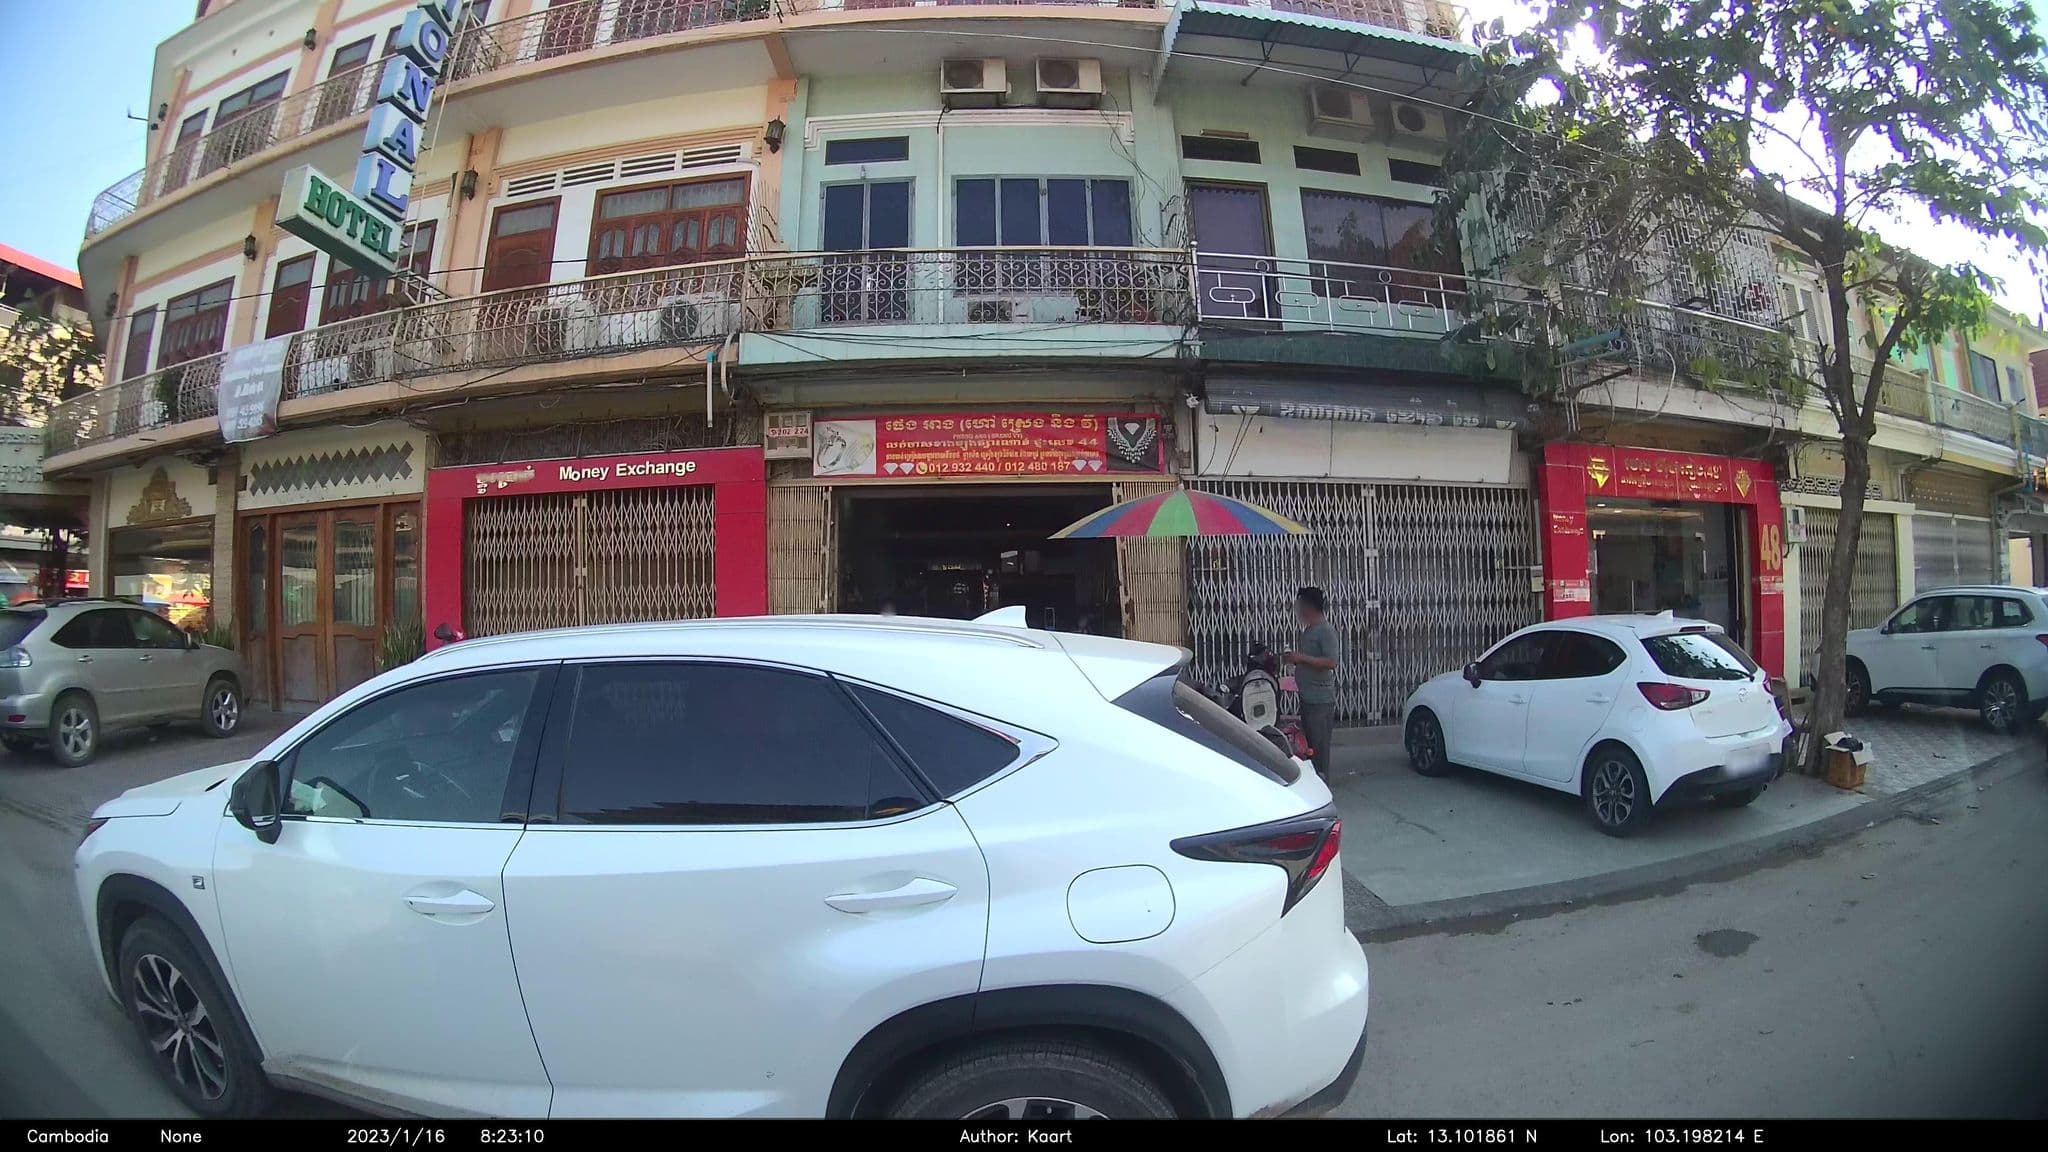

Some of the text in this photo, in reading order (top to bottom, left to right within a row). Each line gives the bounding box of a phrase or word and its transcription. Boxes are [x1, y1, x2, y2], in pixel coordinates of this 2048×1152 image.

[304, 175, 398, 262] HOTEL
[559, 461, 696, 481] Money Exchange
[929, 463, 949, 472] 012
[952, 463, 972, 472] 932
[975, 463, 995, 472] 440
[1005, 462, 1025, 471] 012
[1028, 462, 1047, 471] 480
[1051, 462, 1070, 471] 187
[1761, 524, 1781, 571] 48
